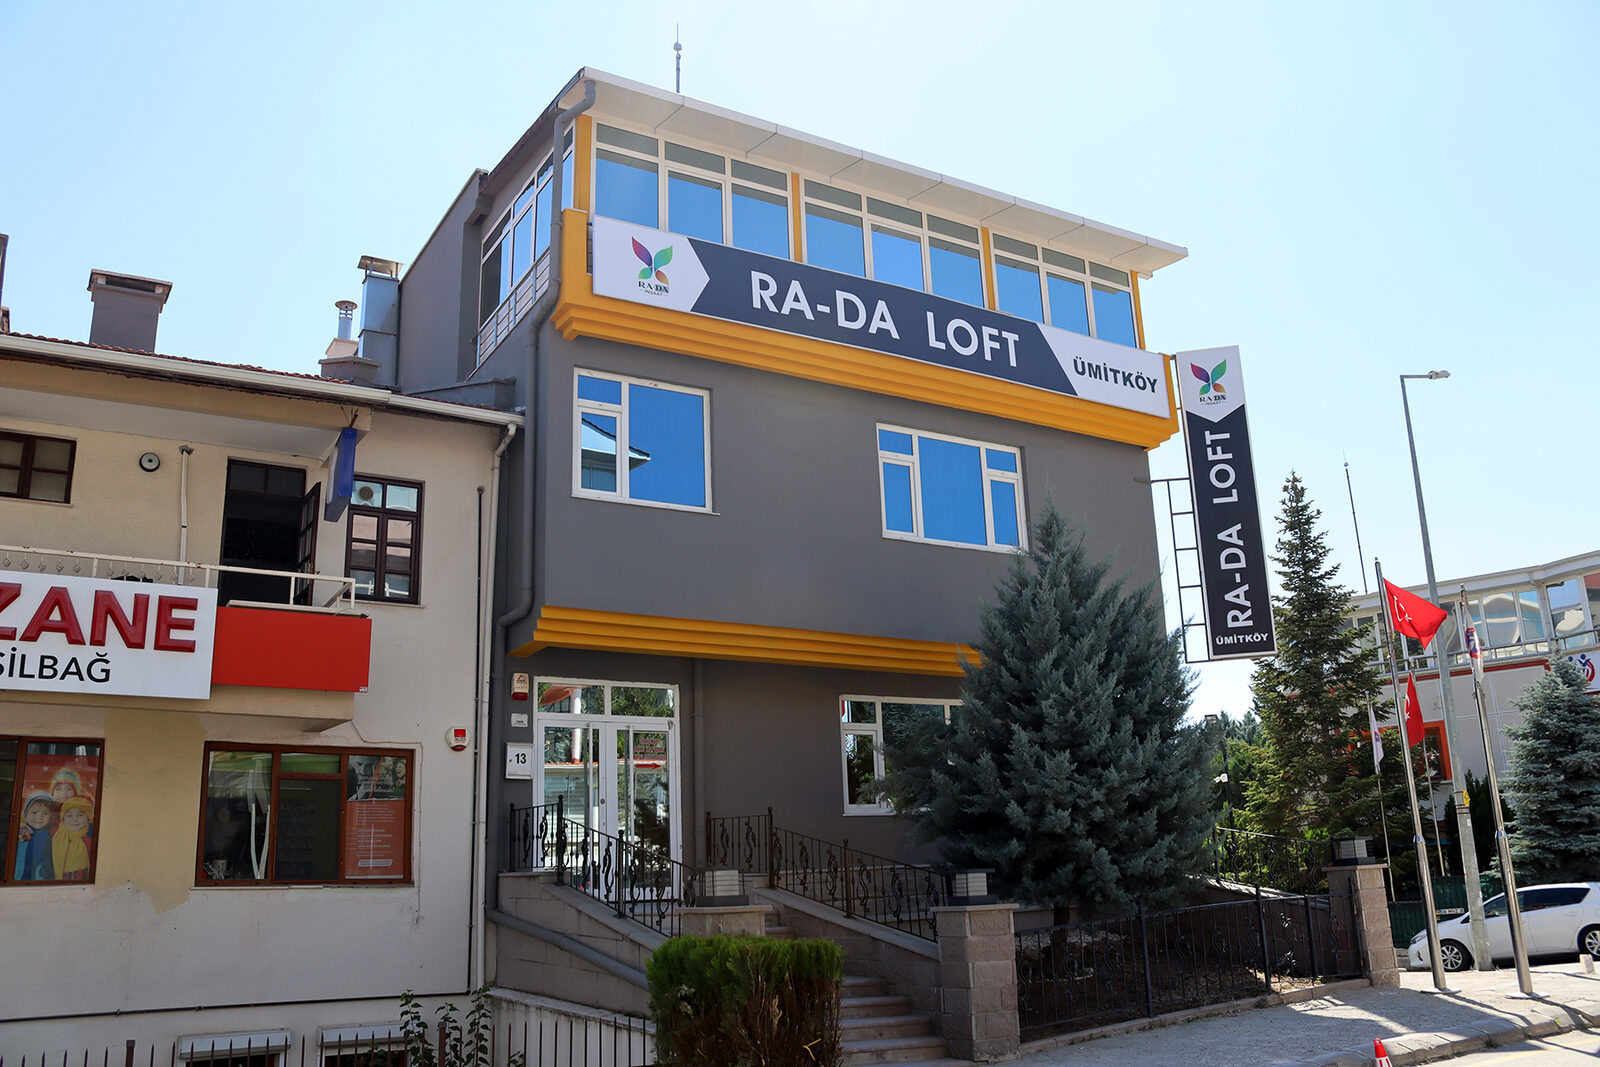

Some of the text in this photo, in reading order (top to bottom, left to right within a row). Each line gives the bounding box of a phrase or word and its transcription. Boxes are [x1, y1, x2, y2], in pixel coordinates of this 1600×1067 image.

[751, 270, 1020, 368] RA-DA LOFT
[1073, 356, 1158, 393] ÜMİTKÖY
[1204, 430, 1254, 628] RA-DA LOFT
[1215, 632, 1269, 645] ÜMİTKÖY
[0, 646, 111, 683] İLBAĞ
[515, 753, 527, 764] 13
